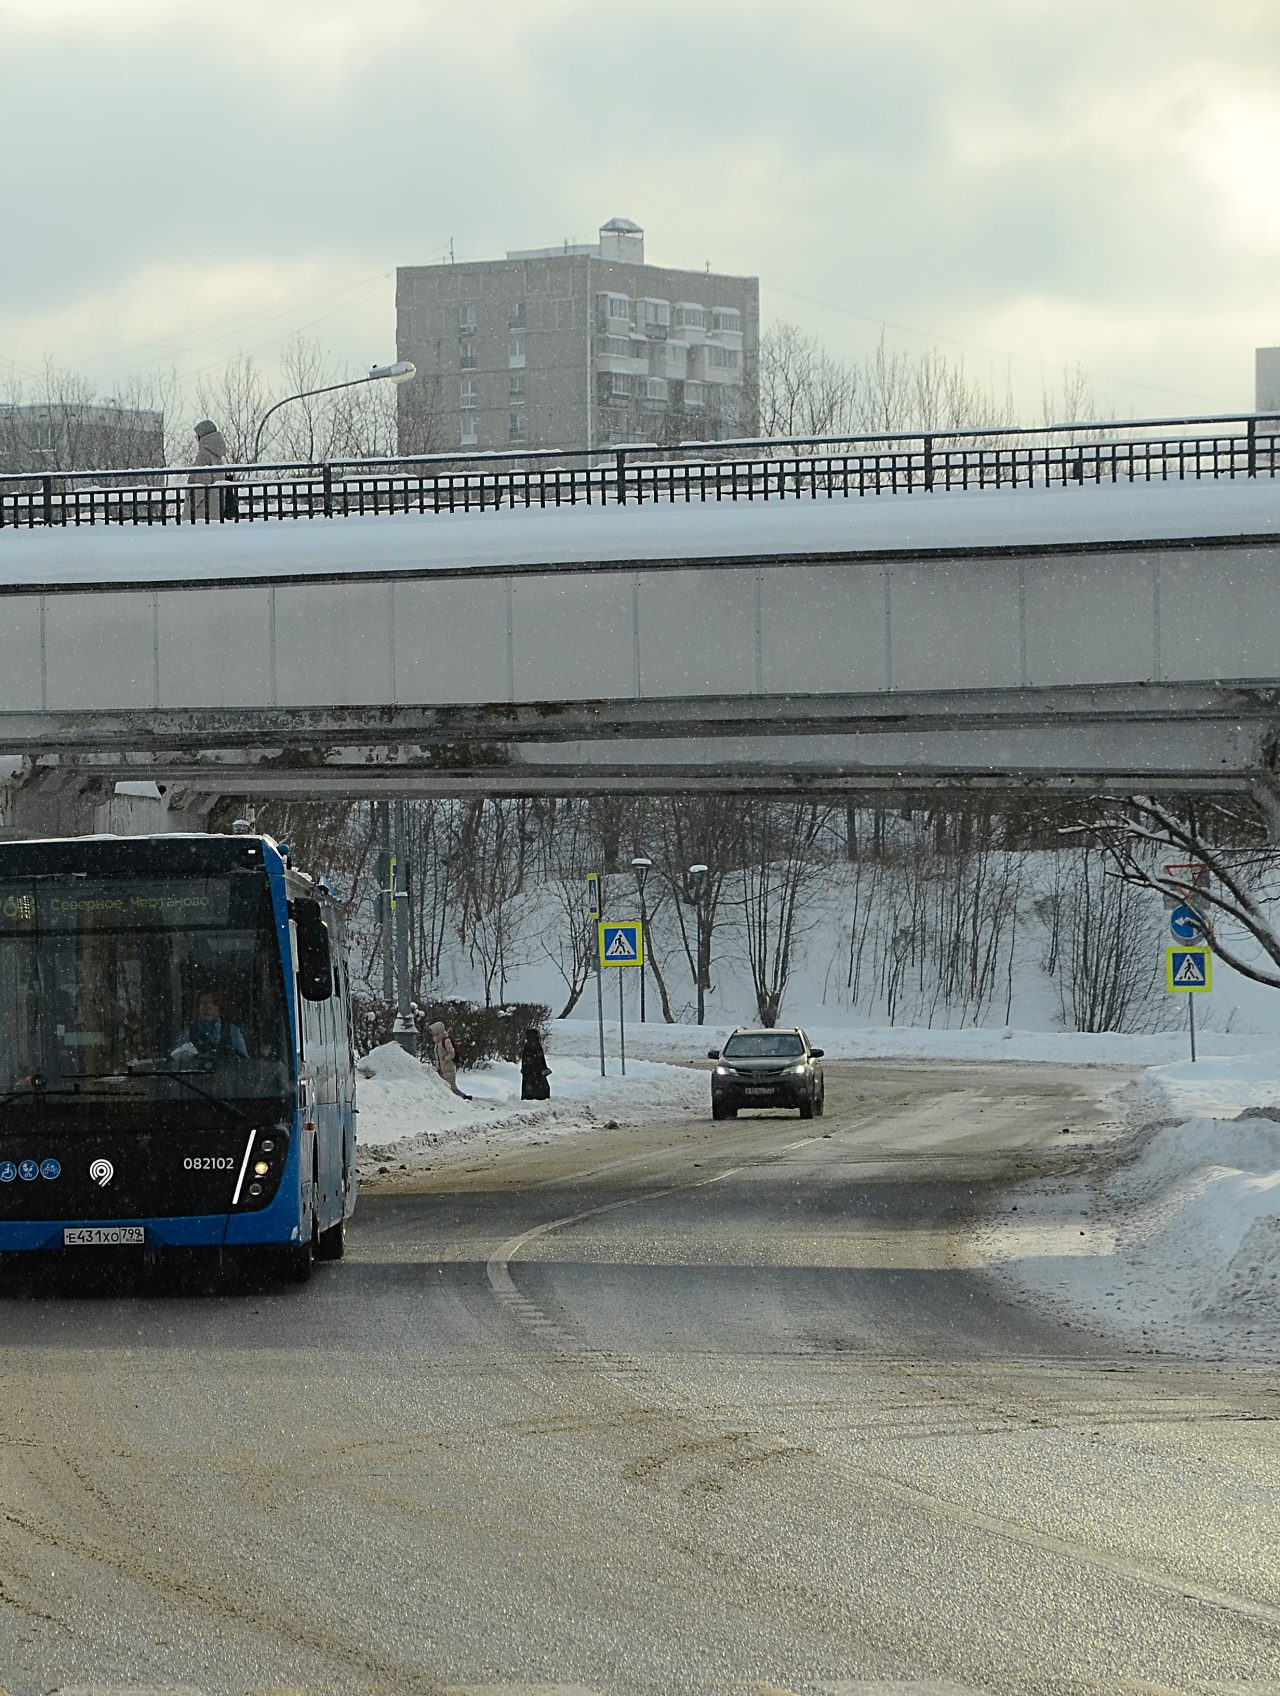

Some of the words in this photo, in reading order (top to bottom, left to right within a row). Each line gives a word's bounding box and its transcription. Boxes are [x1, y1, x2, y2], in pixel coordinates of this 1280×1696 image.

[51, 898, 124, 911] Северное
[130, 896, 210, 909] Чертаново
[183, 1157, 234, 1170] 082102
